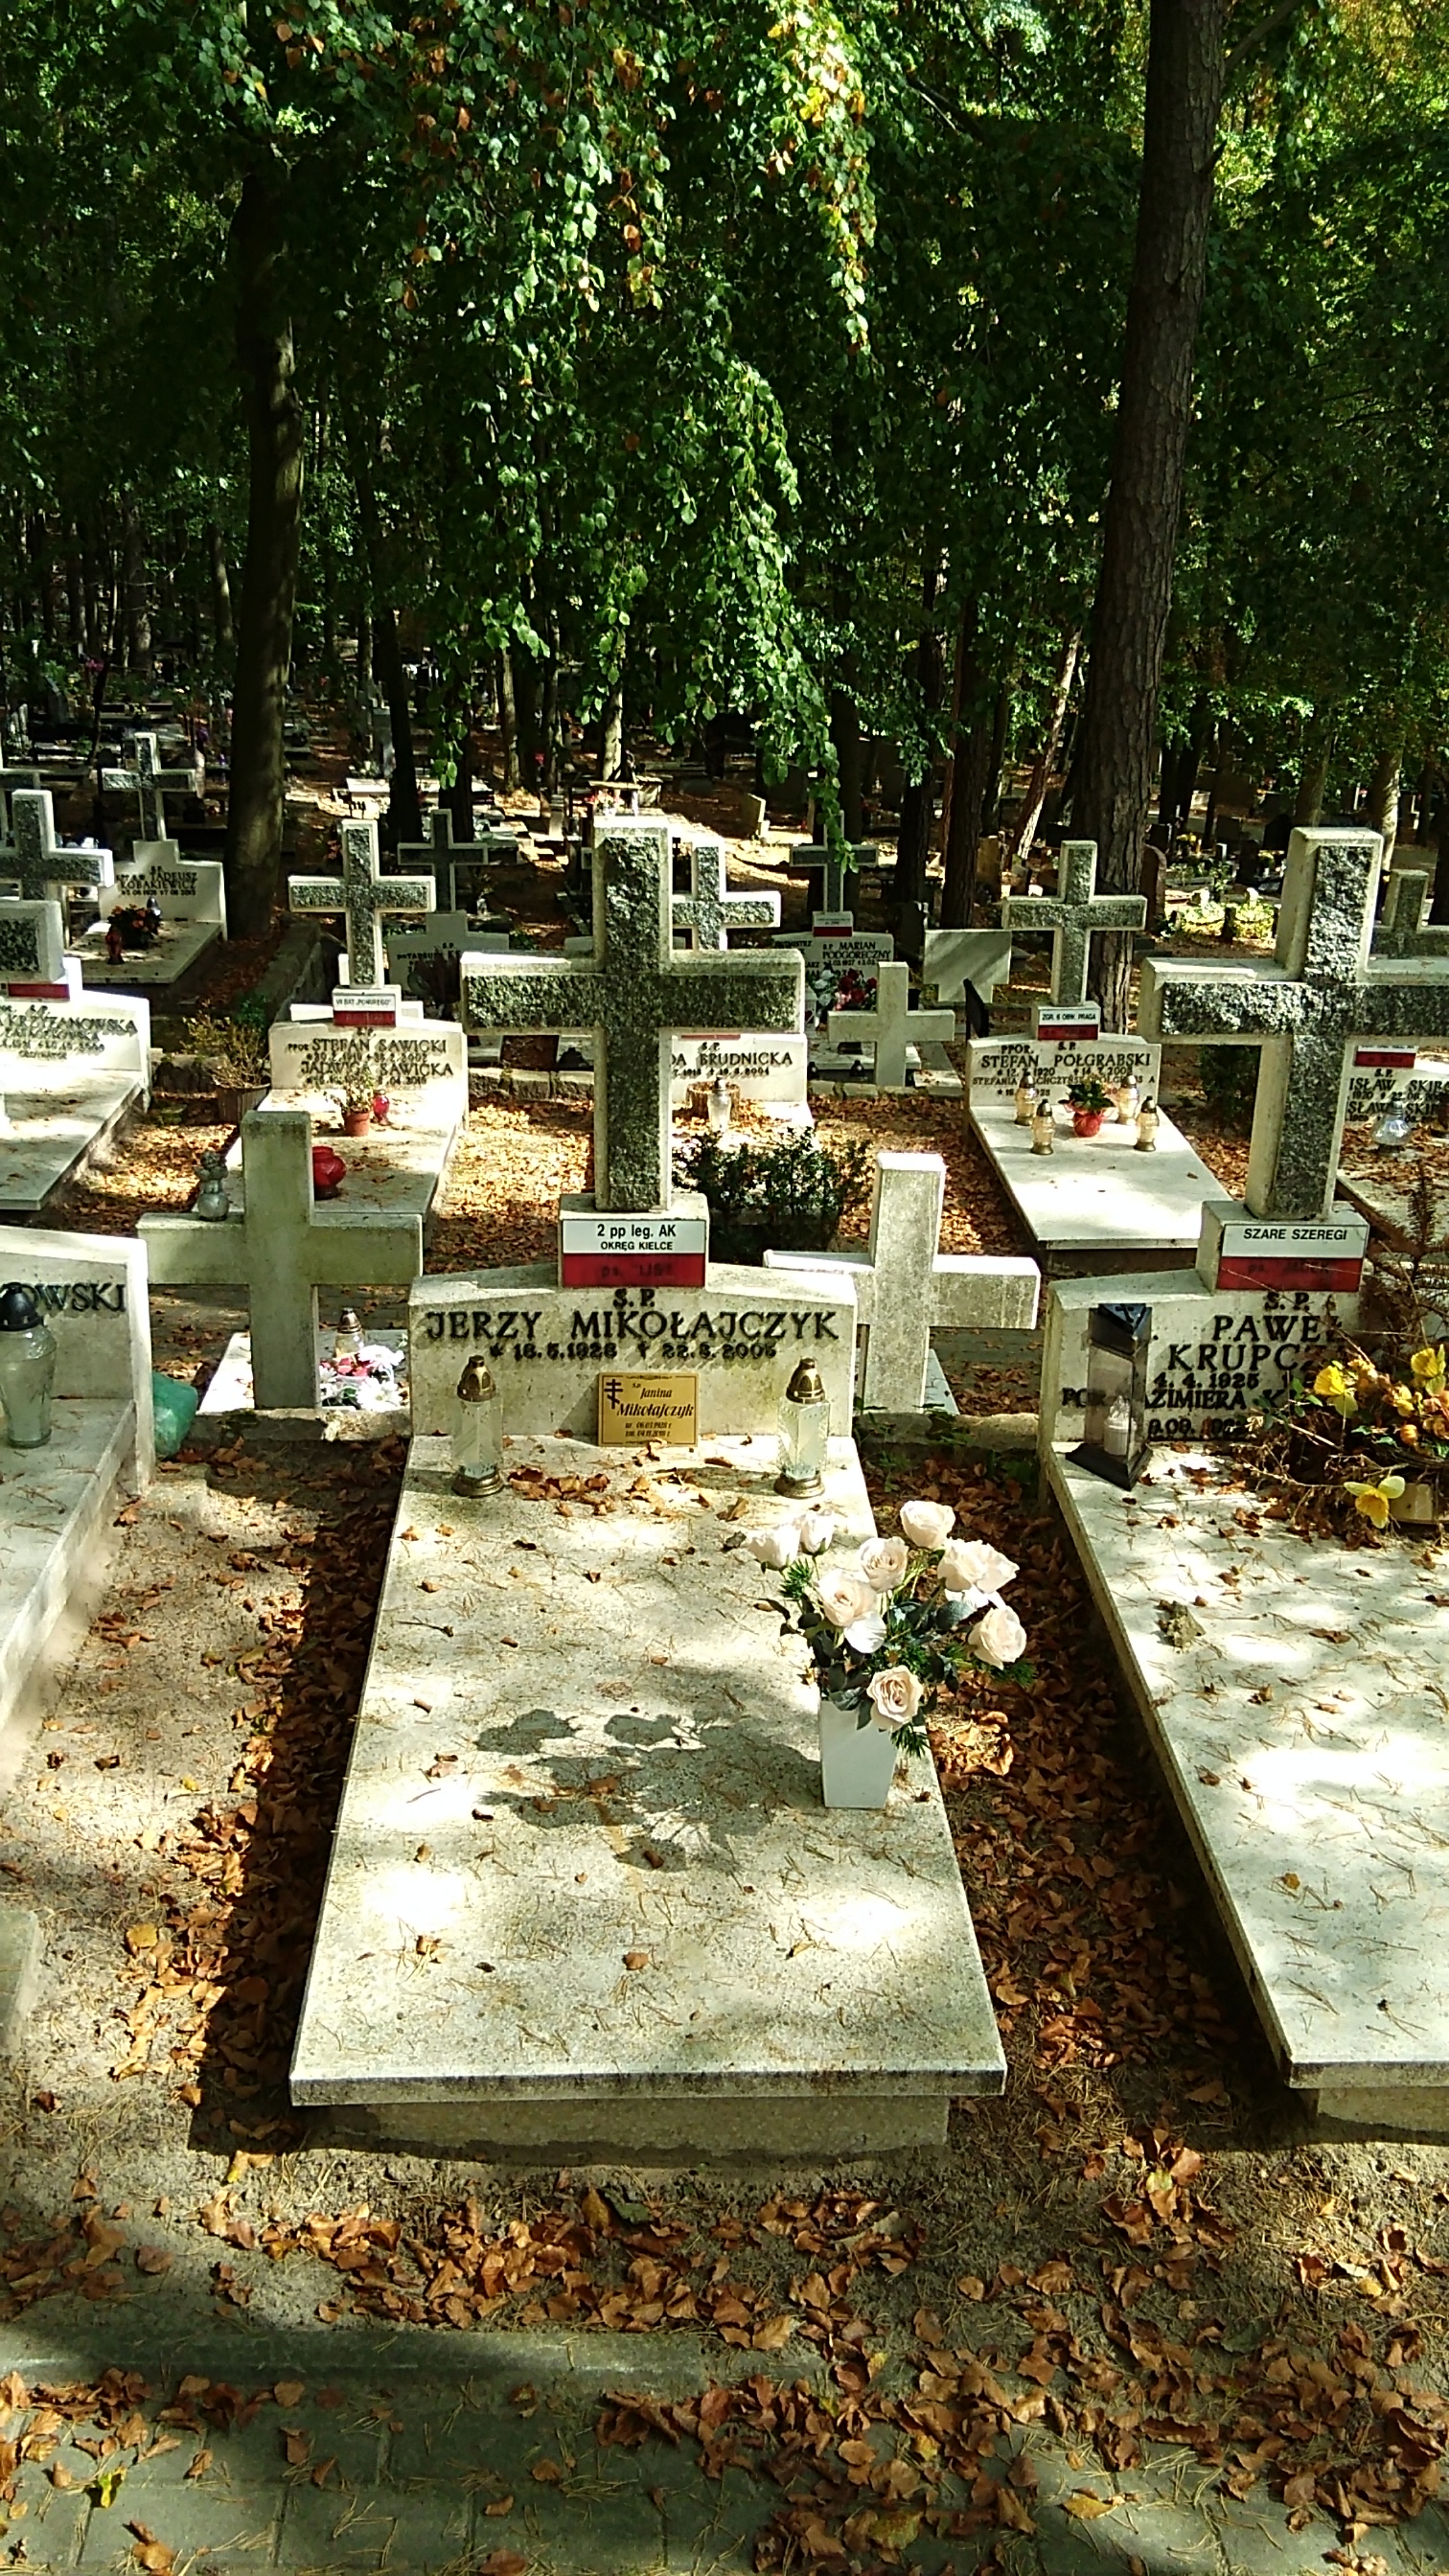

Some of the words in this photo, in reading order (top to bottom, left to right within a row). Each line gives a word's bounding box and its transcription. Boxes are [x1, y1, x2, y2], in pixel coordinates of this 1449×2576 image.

[839, 941, 876, 950] MARIAN
[311, 1039, 370, 1051] STEFAN
[379, 1039, 447, 1052] SAWICKI
[699, 1052, 793, 1066] BRUDNICKA
[980, 1054, 1039, 1068] STEFAN
[380, 1063, 454, 1076] SAWICKA
[597, 1224, 605, 1236] 2
[610, 1227, 626, 1239] pp
[632, 1224, 654, 1239] leg.
[658, 1224, 677, 1236] AK
[1244, 1229, 1286, 1239] SZARE
[1292, 1230, 1347, 1240] SZEREGI
[601, 1241, 634, 1251] OKRĘG
[639, 1241, 673, 1250] KIELCE
[426, 1311, 542, 1339] JERZY
[570, 1310, 839, 1340] MIKOŁAJCZYK
[640, 1388, 673, 1399] Janina
[1145, 1388, 1247, 1410] ZIMIERA
[617, 1404, 694, 1418] Mikołajczyk
